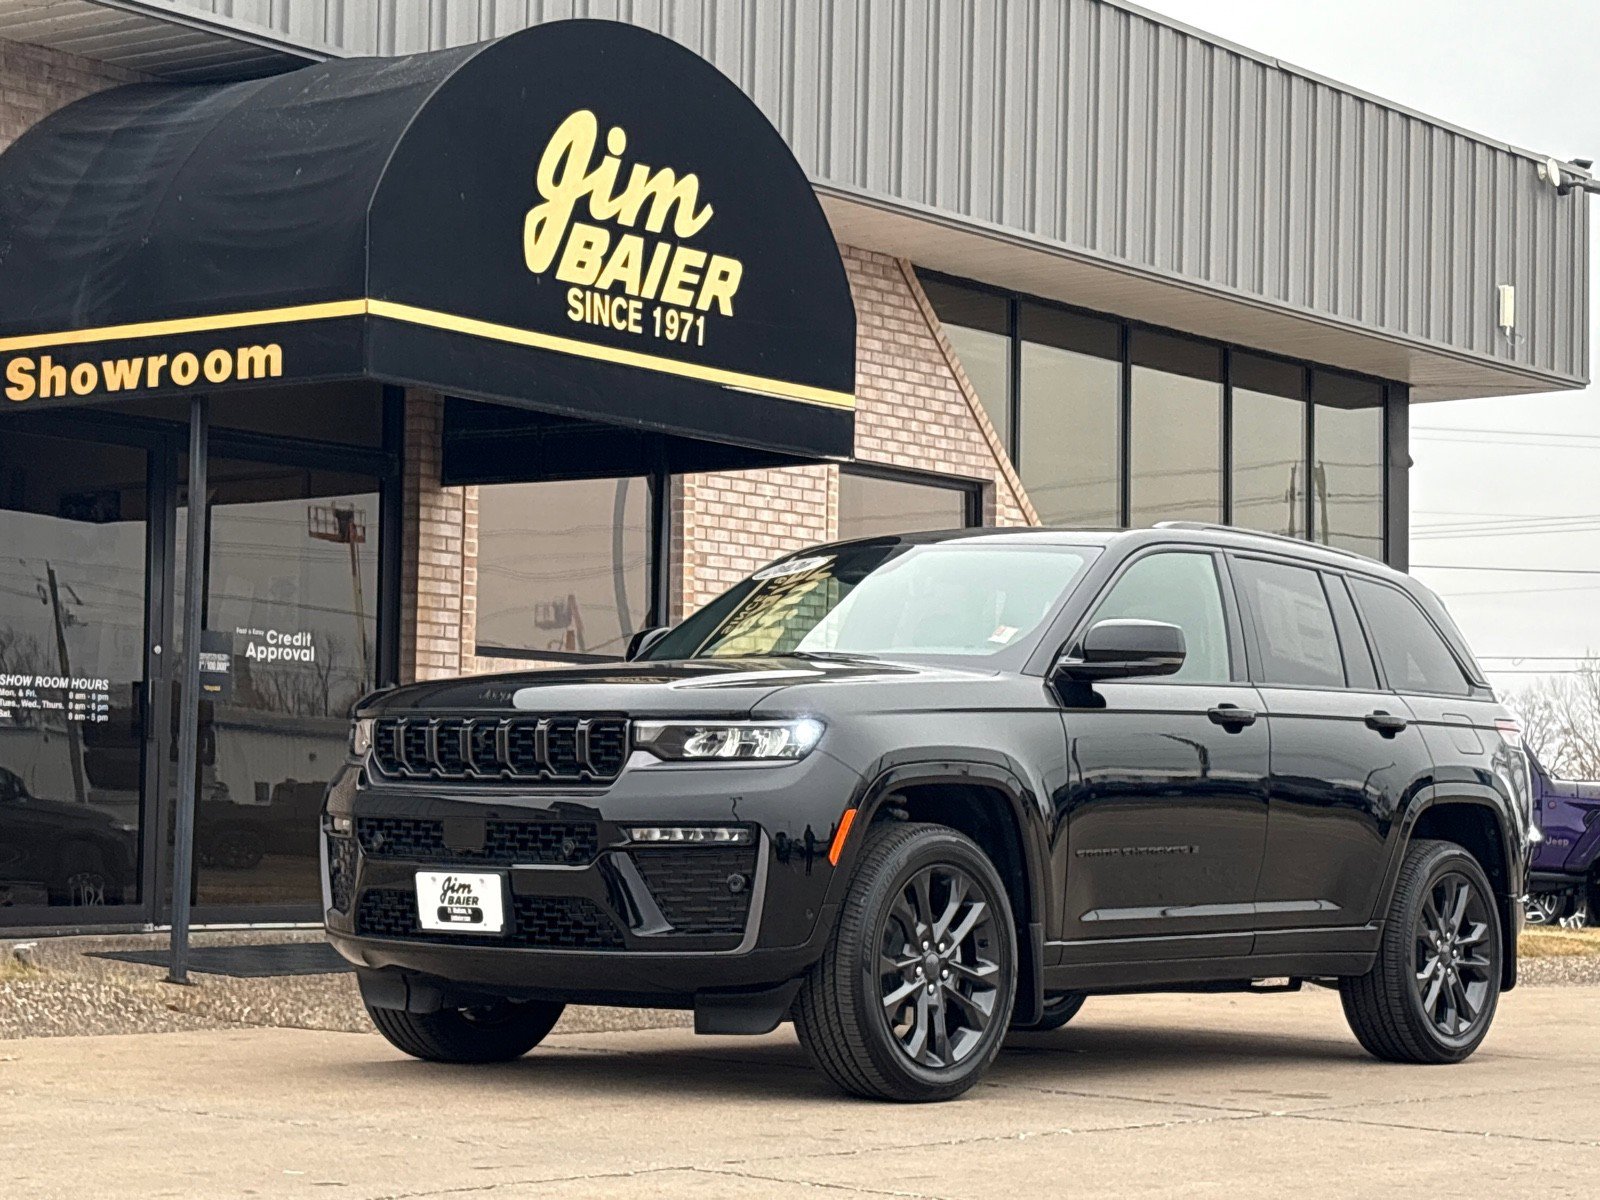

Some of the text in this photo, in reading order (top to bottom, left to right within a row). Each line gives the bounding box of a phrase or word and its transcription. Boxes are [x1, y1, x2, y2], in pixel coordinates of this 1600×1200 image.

[524, 109, 714, 274] Jim
[555, 222, 743, 317] BAIER
[566, 287, 706, 347] SINCE 1971
[5, 343, 282, 401] Showroom
[266, 630, 312, 647] Credit
[245, 641, 315, 663] Approval
[0, 674, 109, 691] SHOW ROOM HOURS
[97, 693, 109, 702] pm
[97, 704, 109, 712] pm
[74, 713, 86, 721] am
[96, 714, 109, 724] pm
[1545, 836, 1569, 847] Jeep
[440, 876, 473, 904] Jim
[448, 896, 480, 906] BAIER
